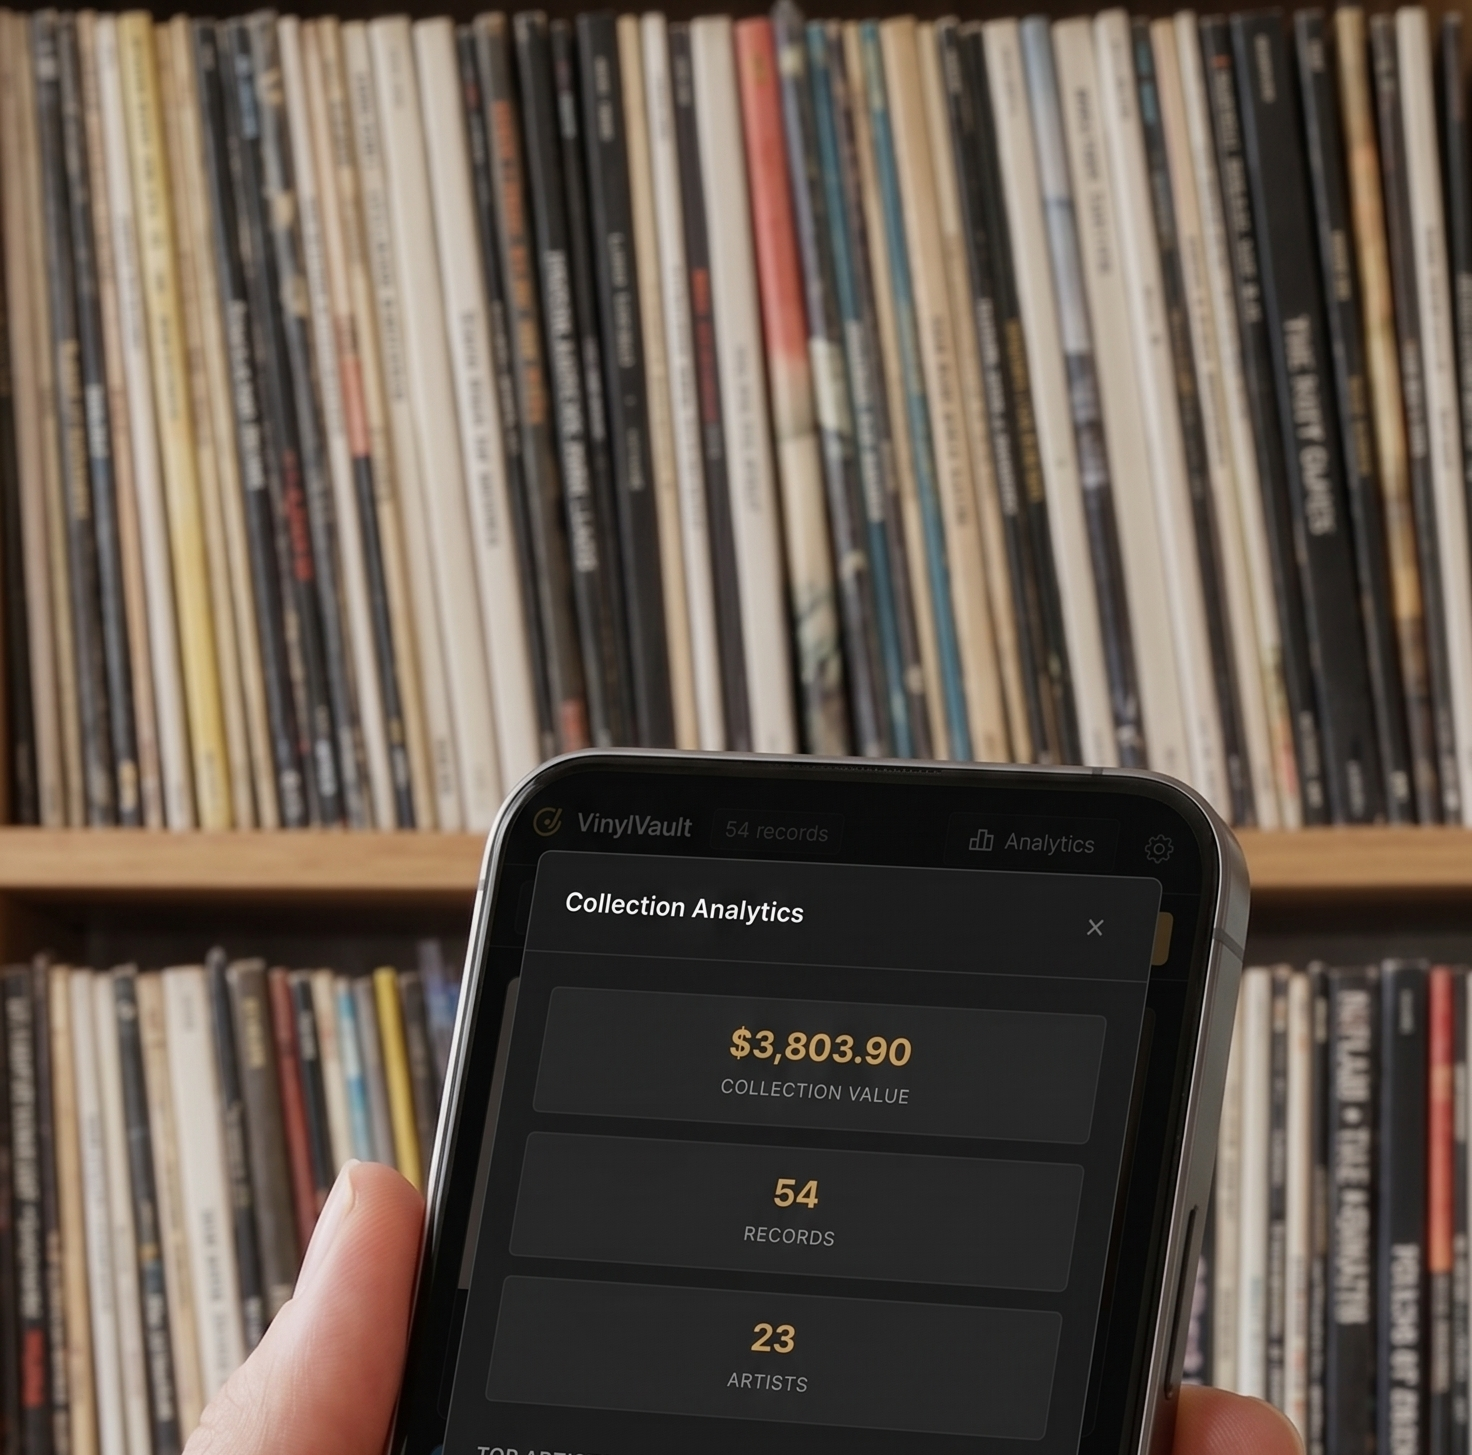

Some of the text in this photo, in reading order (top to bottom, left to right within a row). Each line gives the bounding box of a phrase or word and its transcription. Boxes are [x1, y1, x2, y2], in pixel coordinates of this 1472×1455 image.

[577, 812, 693, 839] VinylVault
[725, 820, 829, 842] 54 records
[1004, 832, 1095, 856] Analytics
[565, 891, 804, 926] Collection Analytics
[729, 1025, 912, 1067] $3,803.90
[721, 1078, 910, 1105] COLLECTION VALUE
[773, 1178, 819, 1209] 54
[743, 1225, 835, 1247] RECORDS
[750, 1322, 796, 1354] 23
[726, 1372, 808, 1393] ARTISTS
